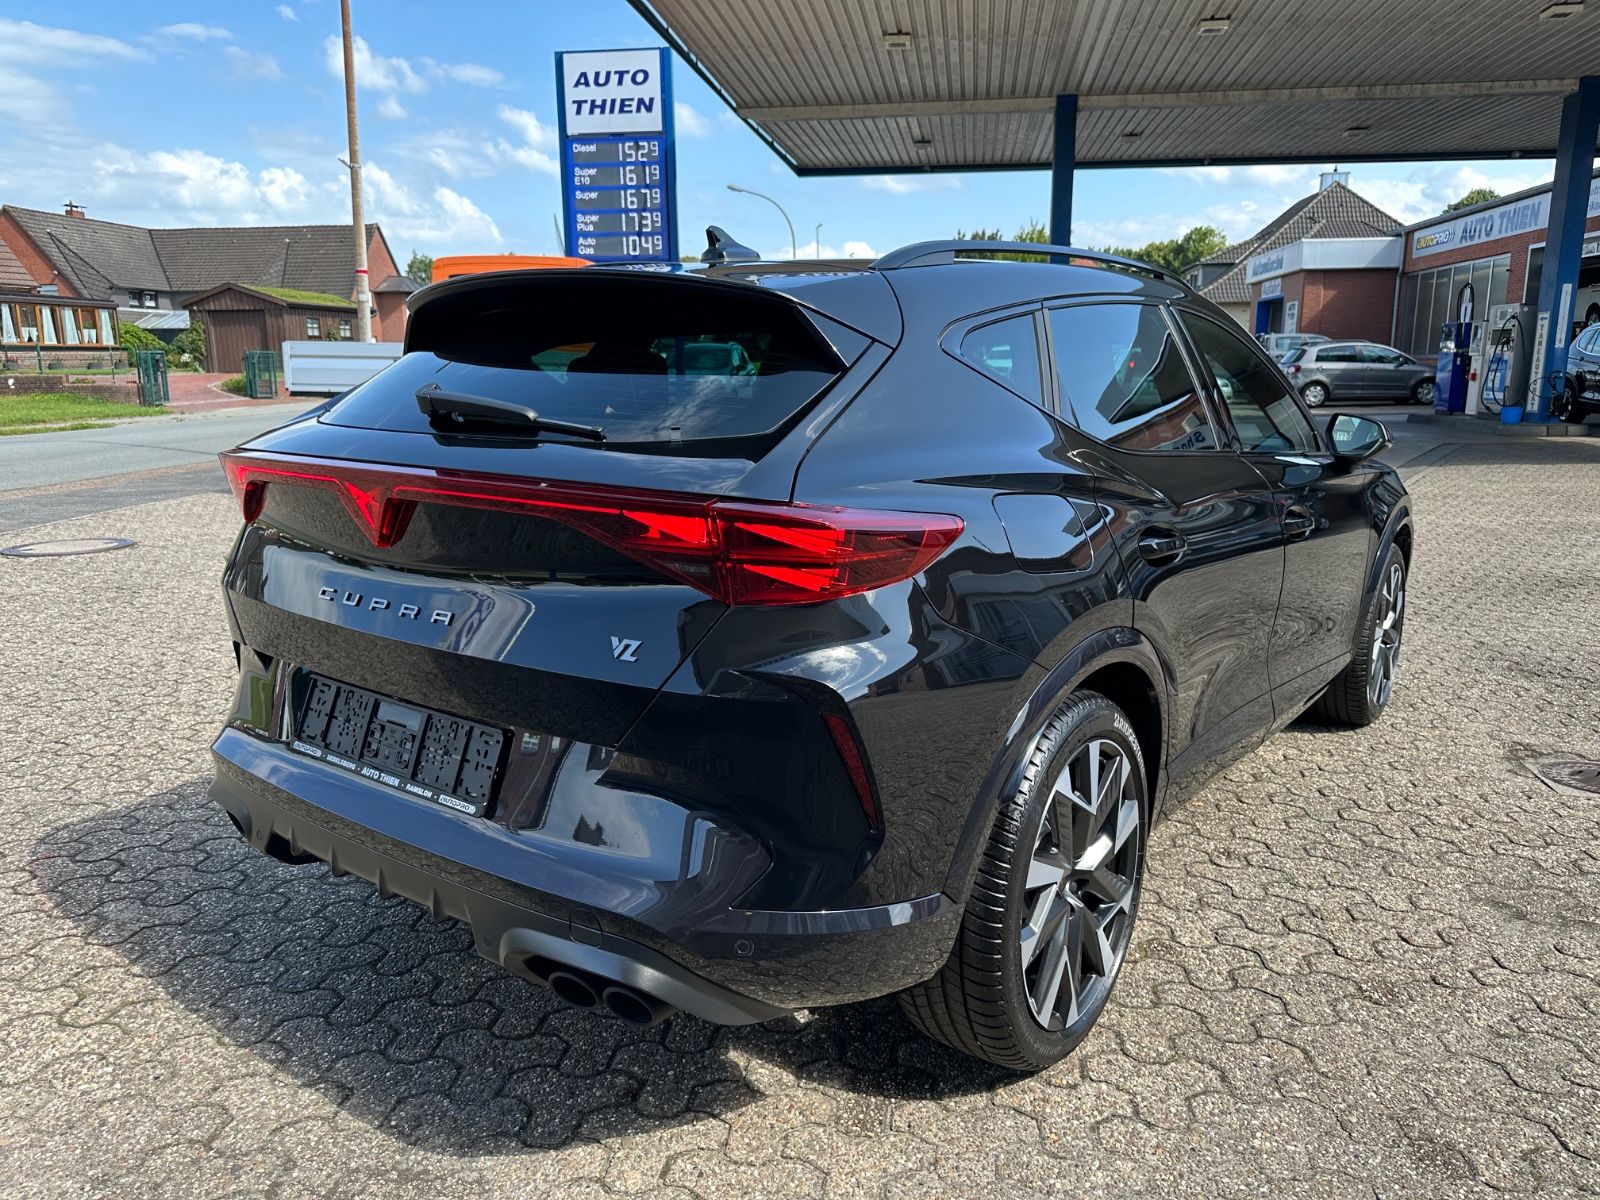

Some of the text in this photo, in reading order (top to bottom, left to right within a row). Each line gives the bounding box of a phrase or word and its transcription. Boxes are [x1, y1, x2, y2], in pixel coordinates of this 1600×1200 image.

[573, 69, 650, 88] AUTO
[572, 97, 655, 116] THIEN
[573, 142, 659, 162] Diesel 1529
[574, 165, 660, 186] Super 1619
[575, 177, 590, 186] E10
[576, 188, 660, 209] Super 1679
[576, 212, 662, 232] Super 1739
[577, 223, 594, 232] Plus
[1460, 214, 1494, 244] AUTO
[1498, 201, 1542, 234] THIEN
[578, 235, 663, 256] Auto 1049
[578, 246, 594, 255] Gas
[318, 586, 456, 626] CUPRA
[610, 635, 644, 662] VZ
[360, 766, 379, 780] AUTO
[380, 773, 400, 787] THIEN
